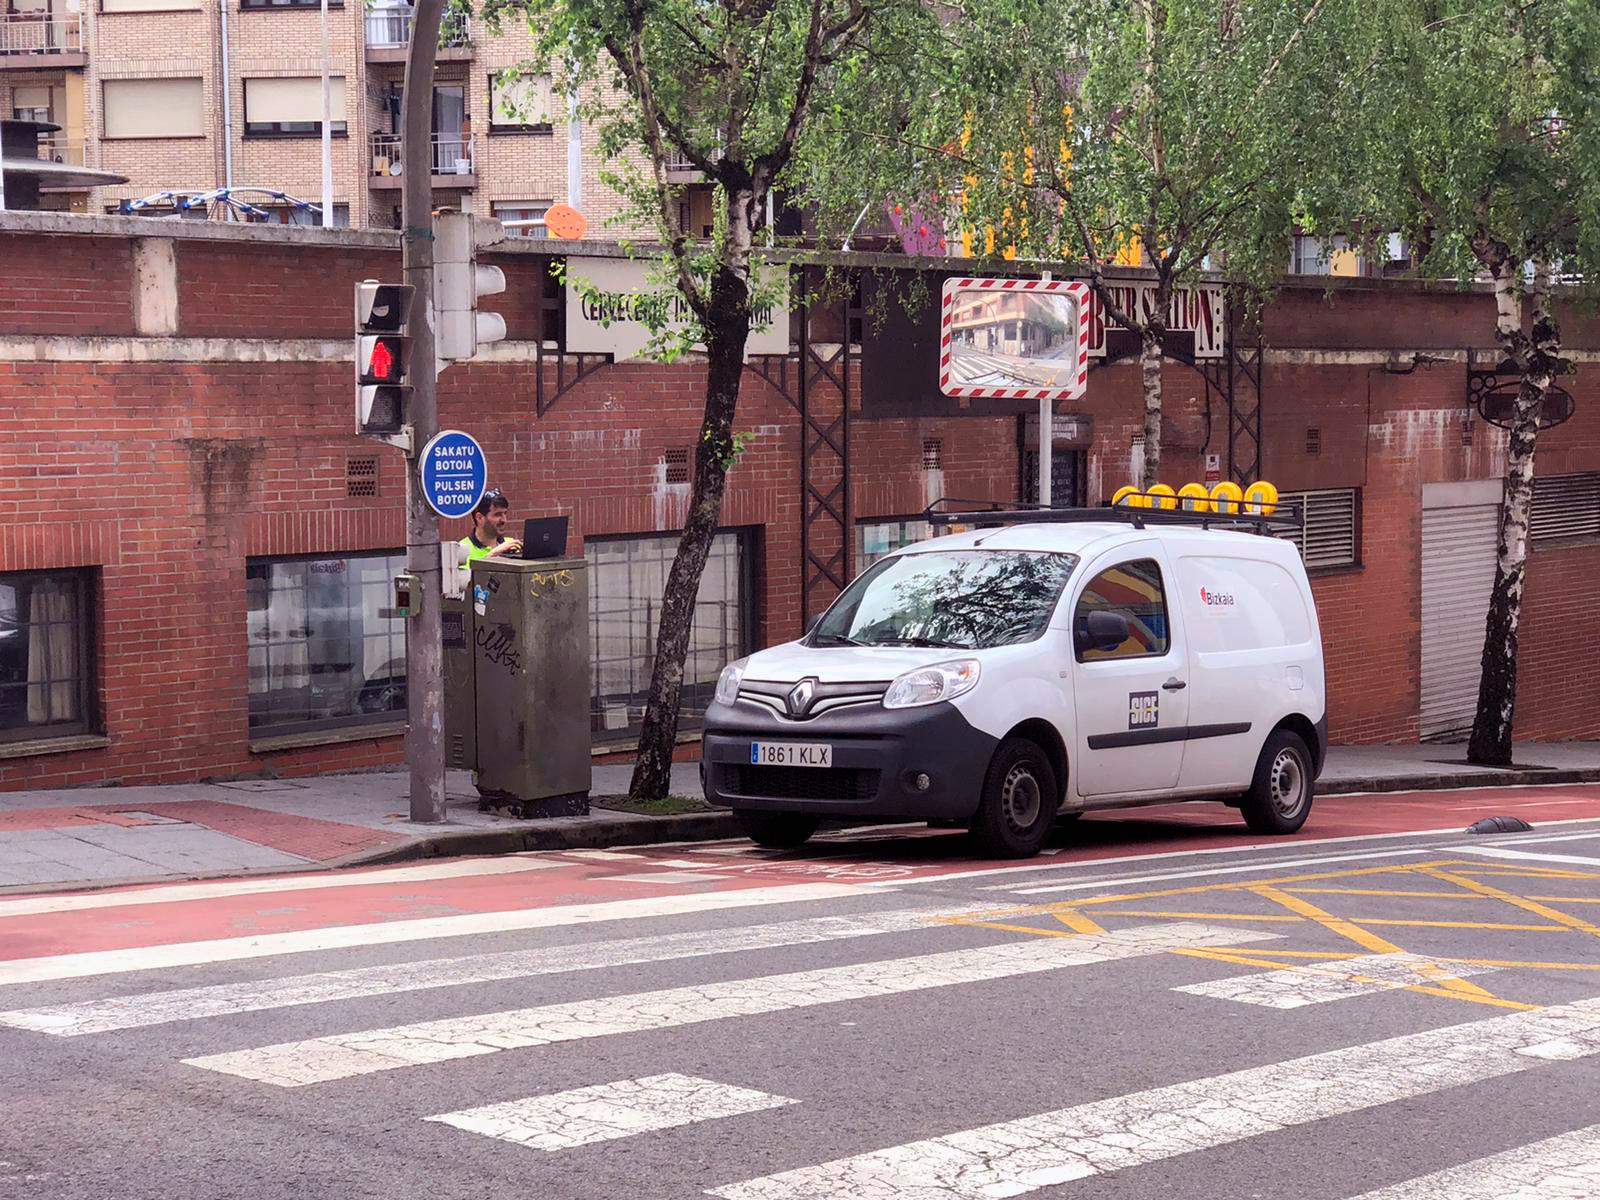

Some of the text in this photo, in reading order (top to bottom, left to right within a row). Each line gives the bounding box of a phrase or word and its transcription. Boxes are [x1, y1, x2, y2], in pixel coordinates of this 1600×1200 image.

[434, 446, 475, 457] SAKATU
[435, 460, 473, 471] BOTOIA
[434, 480, 475, 492] PULSEN
[437, 494, 472, 505] BOTON
[1206, 592, 1234, 605] Bizkaia
[1130, 695, 1158, 725] SICE
[761, 745, 793, 763] 1861
[799, 747, 828, 764] KLX
